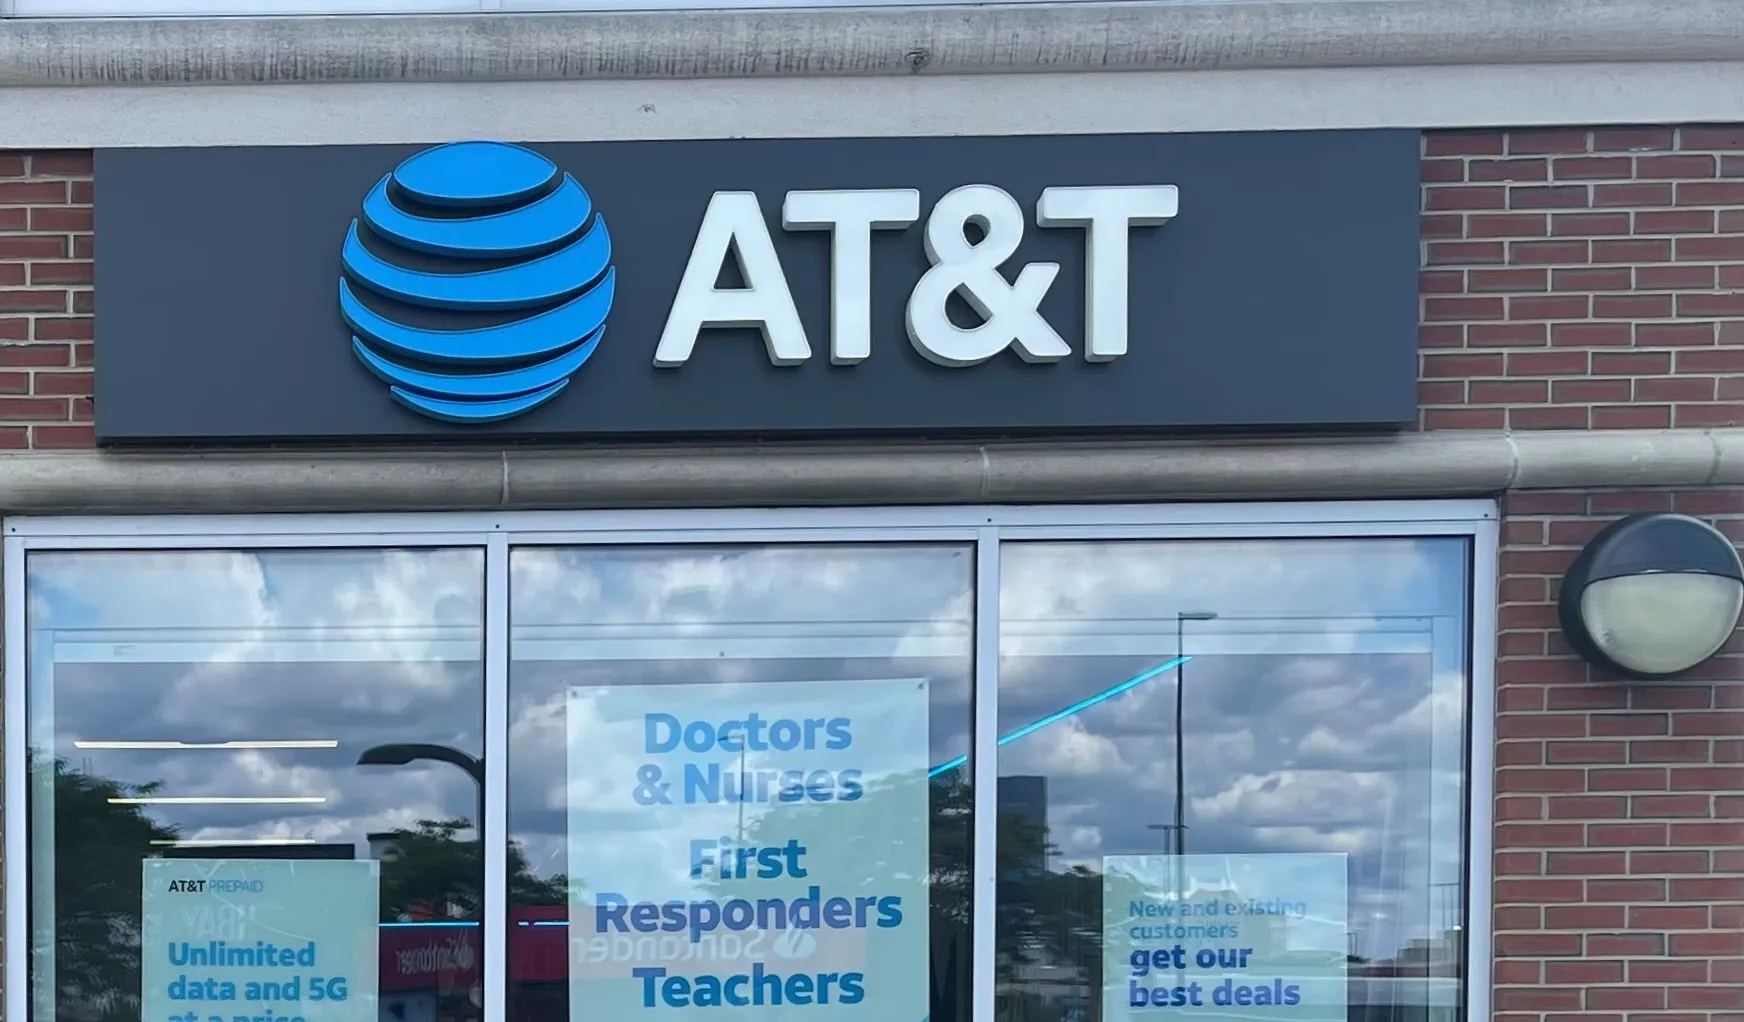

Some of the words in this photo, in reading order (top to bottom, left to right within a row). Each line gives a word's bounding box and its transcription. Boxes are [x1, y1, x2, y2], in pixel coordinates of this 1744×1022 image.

[653, 184, 1179, 368] AT&T
[644, 712, 852, 754] Doctors
[632, 764, 674, 806] &
[684, 763, 864, 804] Nurses
[690, 836, 808, 880] First
[168, 880, 206, 892] AT&T
[208, 880, 264, 893] PREPAID
[595, 886, 903, 943] Responders
[1129, 900, 1175, 917] New
[1180, 899, 1219, 916] and
[1224, 897, 1306, 918] existing
[1129, 922, 1239, 940] customers
[168, 942, 316, 967] Unlimited
[1129, 945, 1187, 976] get
[1196, 948, 1254, 968] our
[168, 975, 236, 1001] data
[244, 975, 301, 1001] and
[308, 977, 348, 1001] 5G
[632, 963, 866, 1008] Teachers
[1129, 980, 1203, 1007] best
[1212, 978, 1302, 1007] deals
